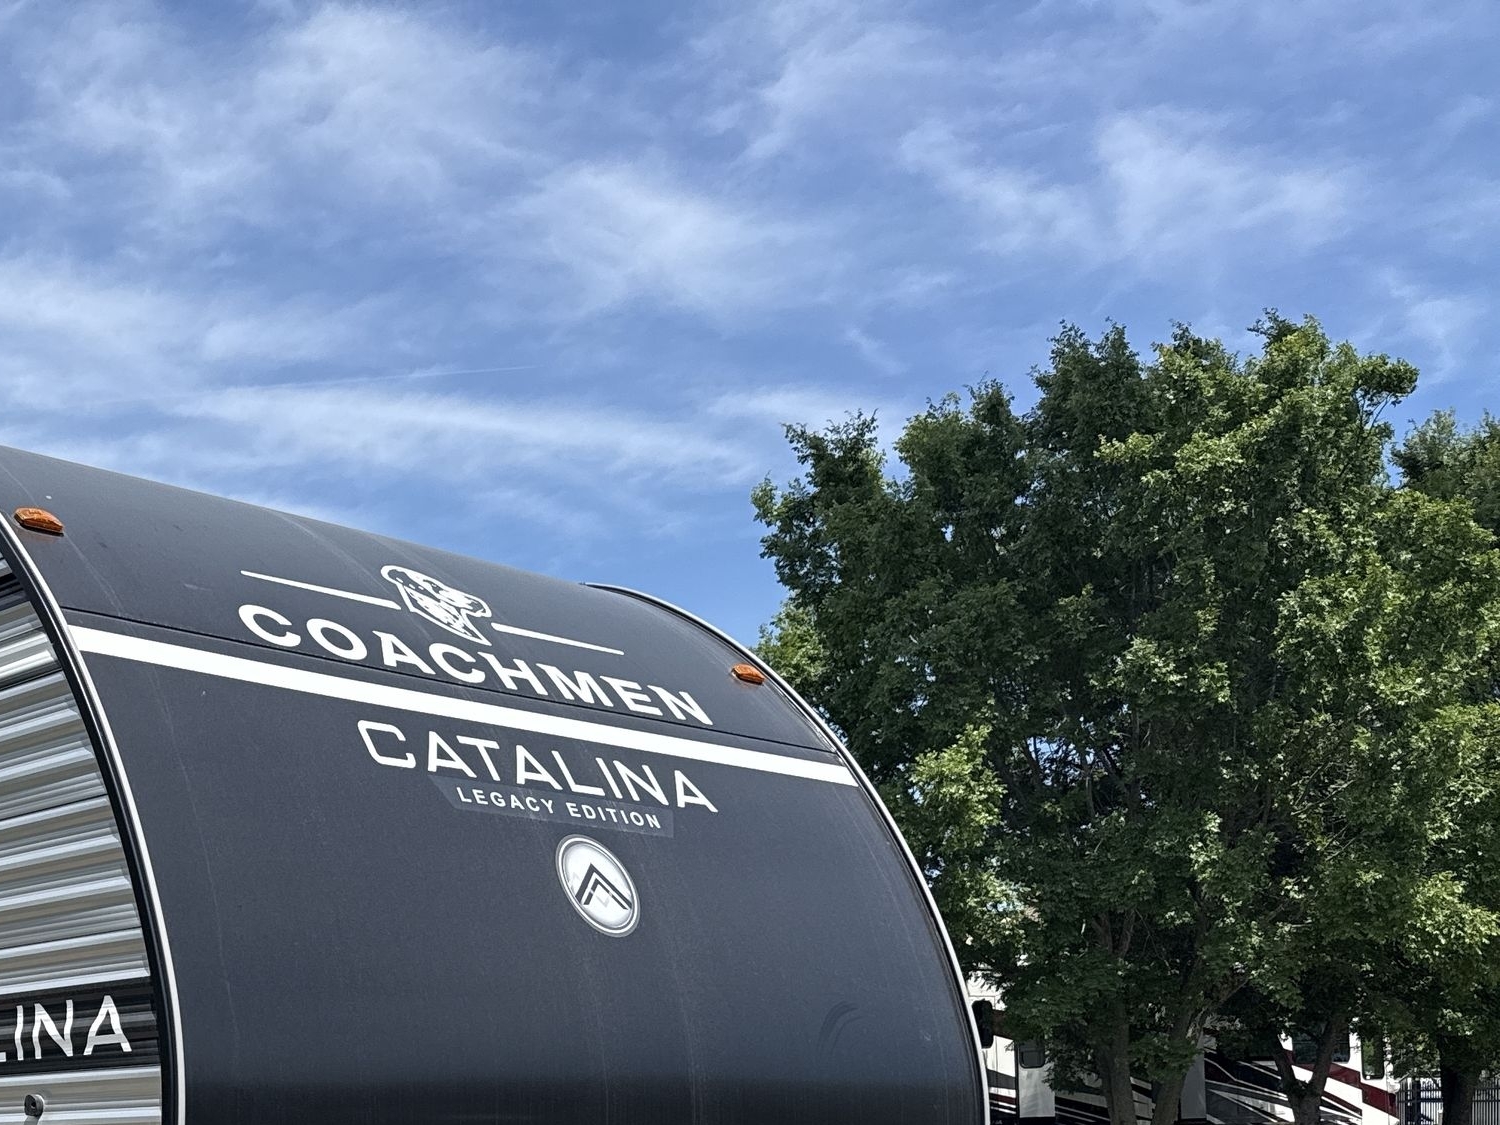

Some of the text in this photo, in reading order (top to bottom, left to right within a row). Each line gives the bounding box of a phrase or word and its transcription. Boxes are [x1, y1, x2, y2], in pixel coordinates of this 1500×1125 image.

[238, 603, 715, 727] COACHMEN
[357, 720, 719, 814] CATALINA
[456, 786, 663, 831] LEGACY EDITION
